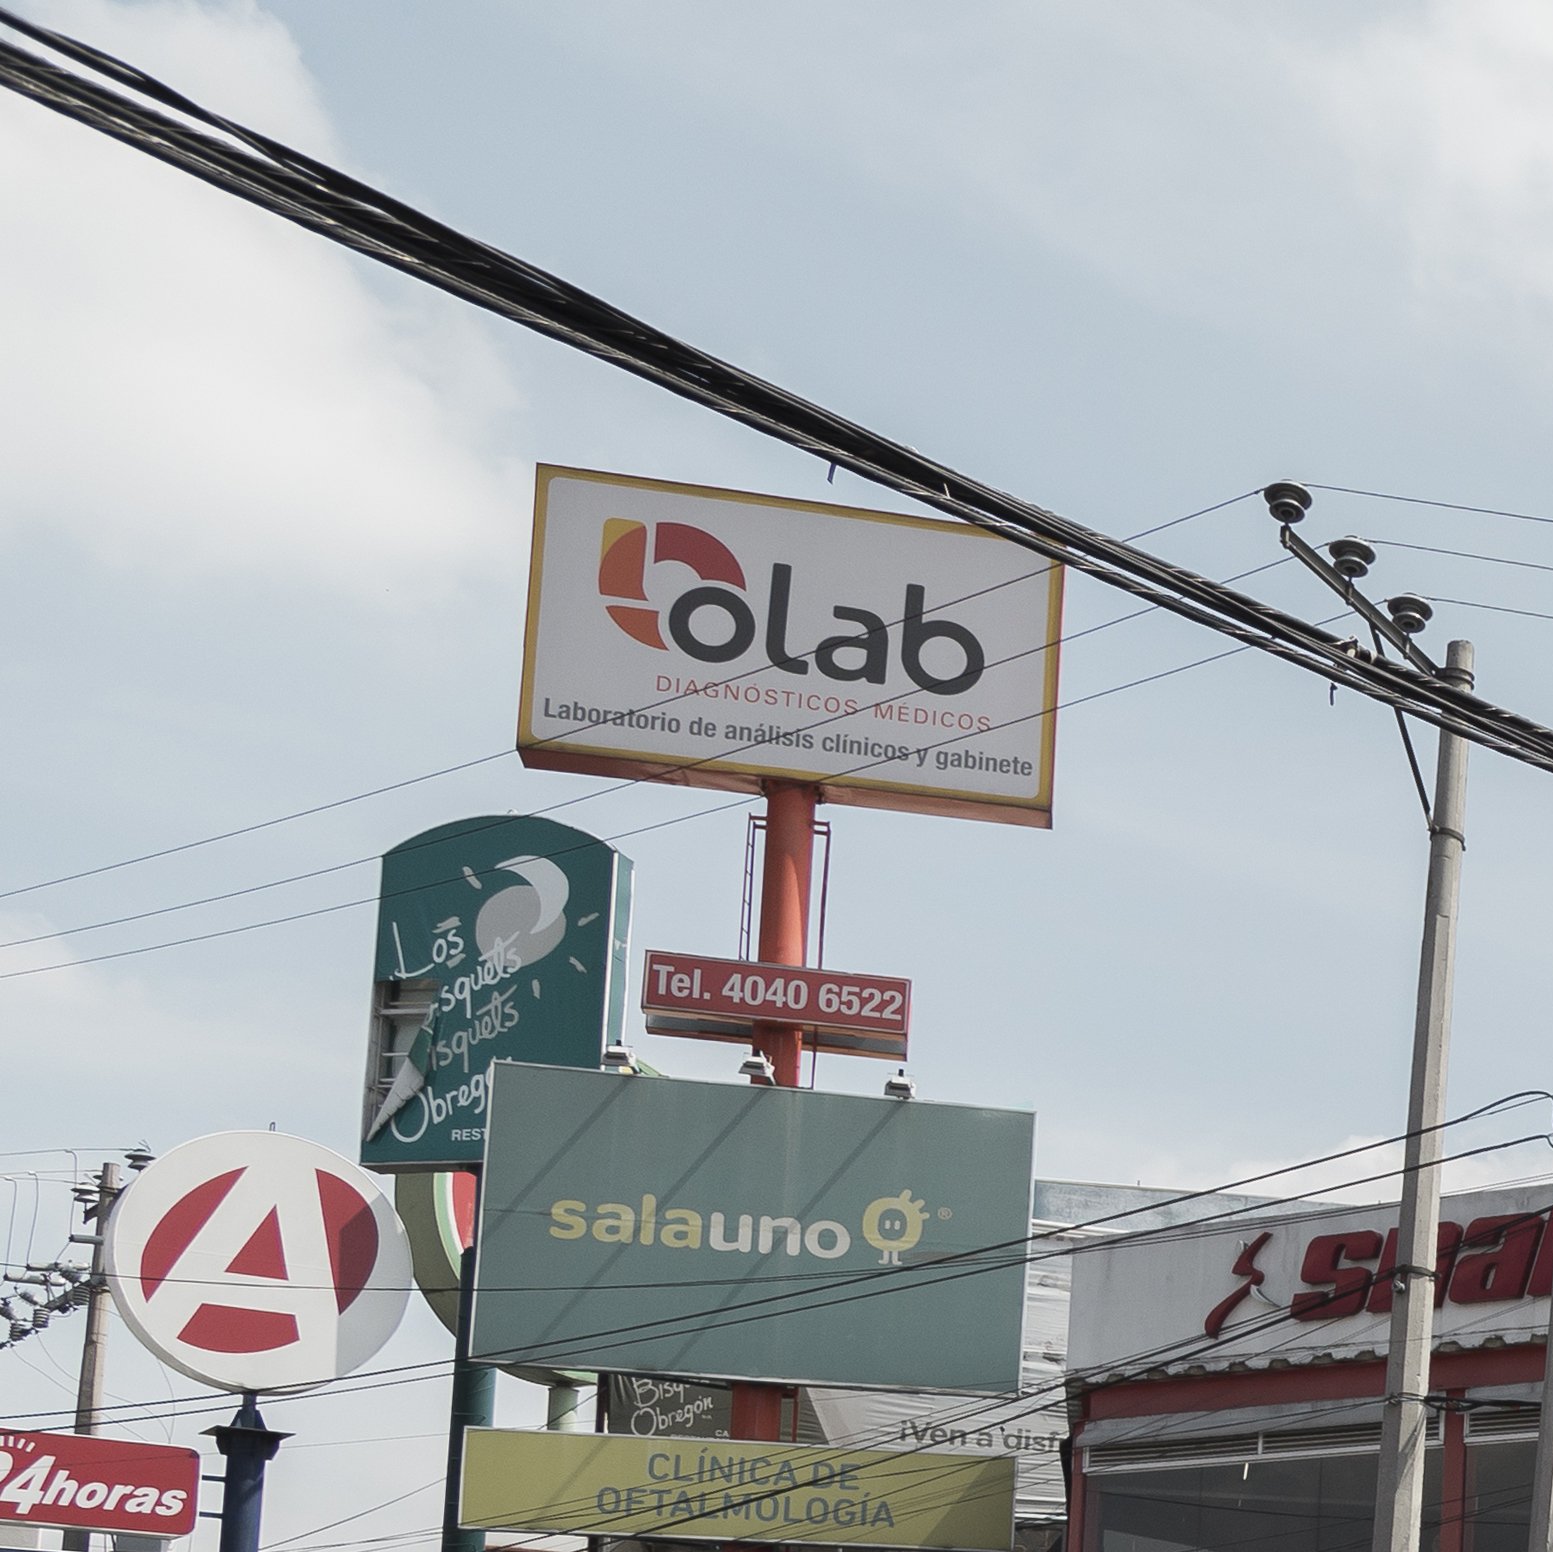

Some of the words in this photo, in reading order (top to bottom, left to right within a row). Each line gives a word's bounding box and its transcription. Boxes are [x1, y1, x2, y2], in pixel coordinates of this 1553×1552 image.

[655, 674, 859, 717] DIAGNÓSTICOS
[873, 700, 993, 733] MÉDICOS
[543, 698, 681, 736] Laboratorio
[688, 715, 717, 740] de
[724, 721, 816, 752] análisis
[821, 733, 910, 762] clínicos
[915, 747, 929, 769] y
[935, 747, 1034, 778] gabinete
[389, 921, 465, 980] Los
[652, 963, 712, 1001] Tel.
[721, 972, 809, 1010] 4040
[817, 982, 904, 1021] 6522
[549, 1193, 851, 1259] salauno
[975, 1430, 994, 1449] a
[646, 1448, 798, 1489] CLÍNICA
[812, 1461, 862, 1491] DE
[596, 1487, 896, 1529] OFTALMOLOGÍA
